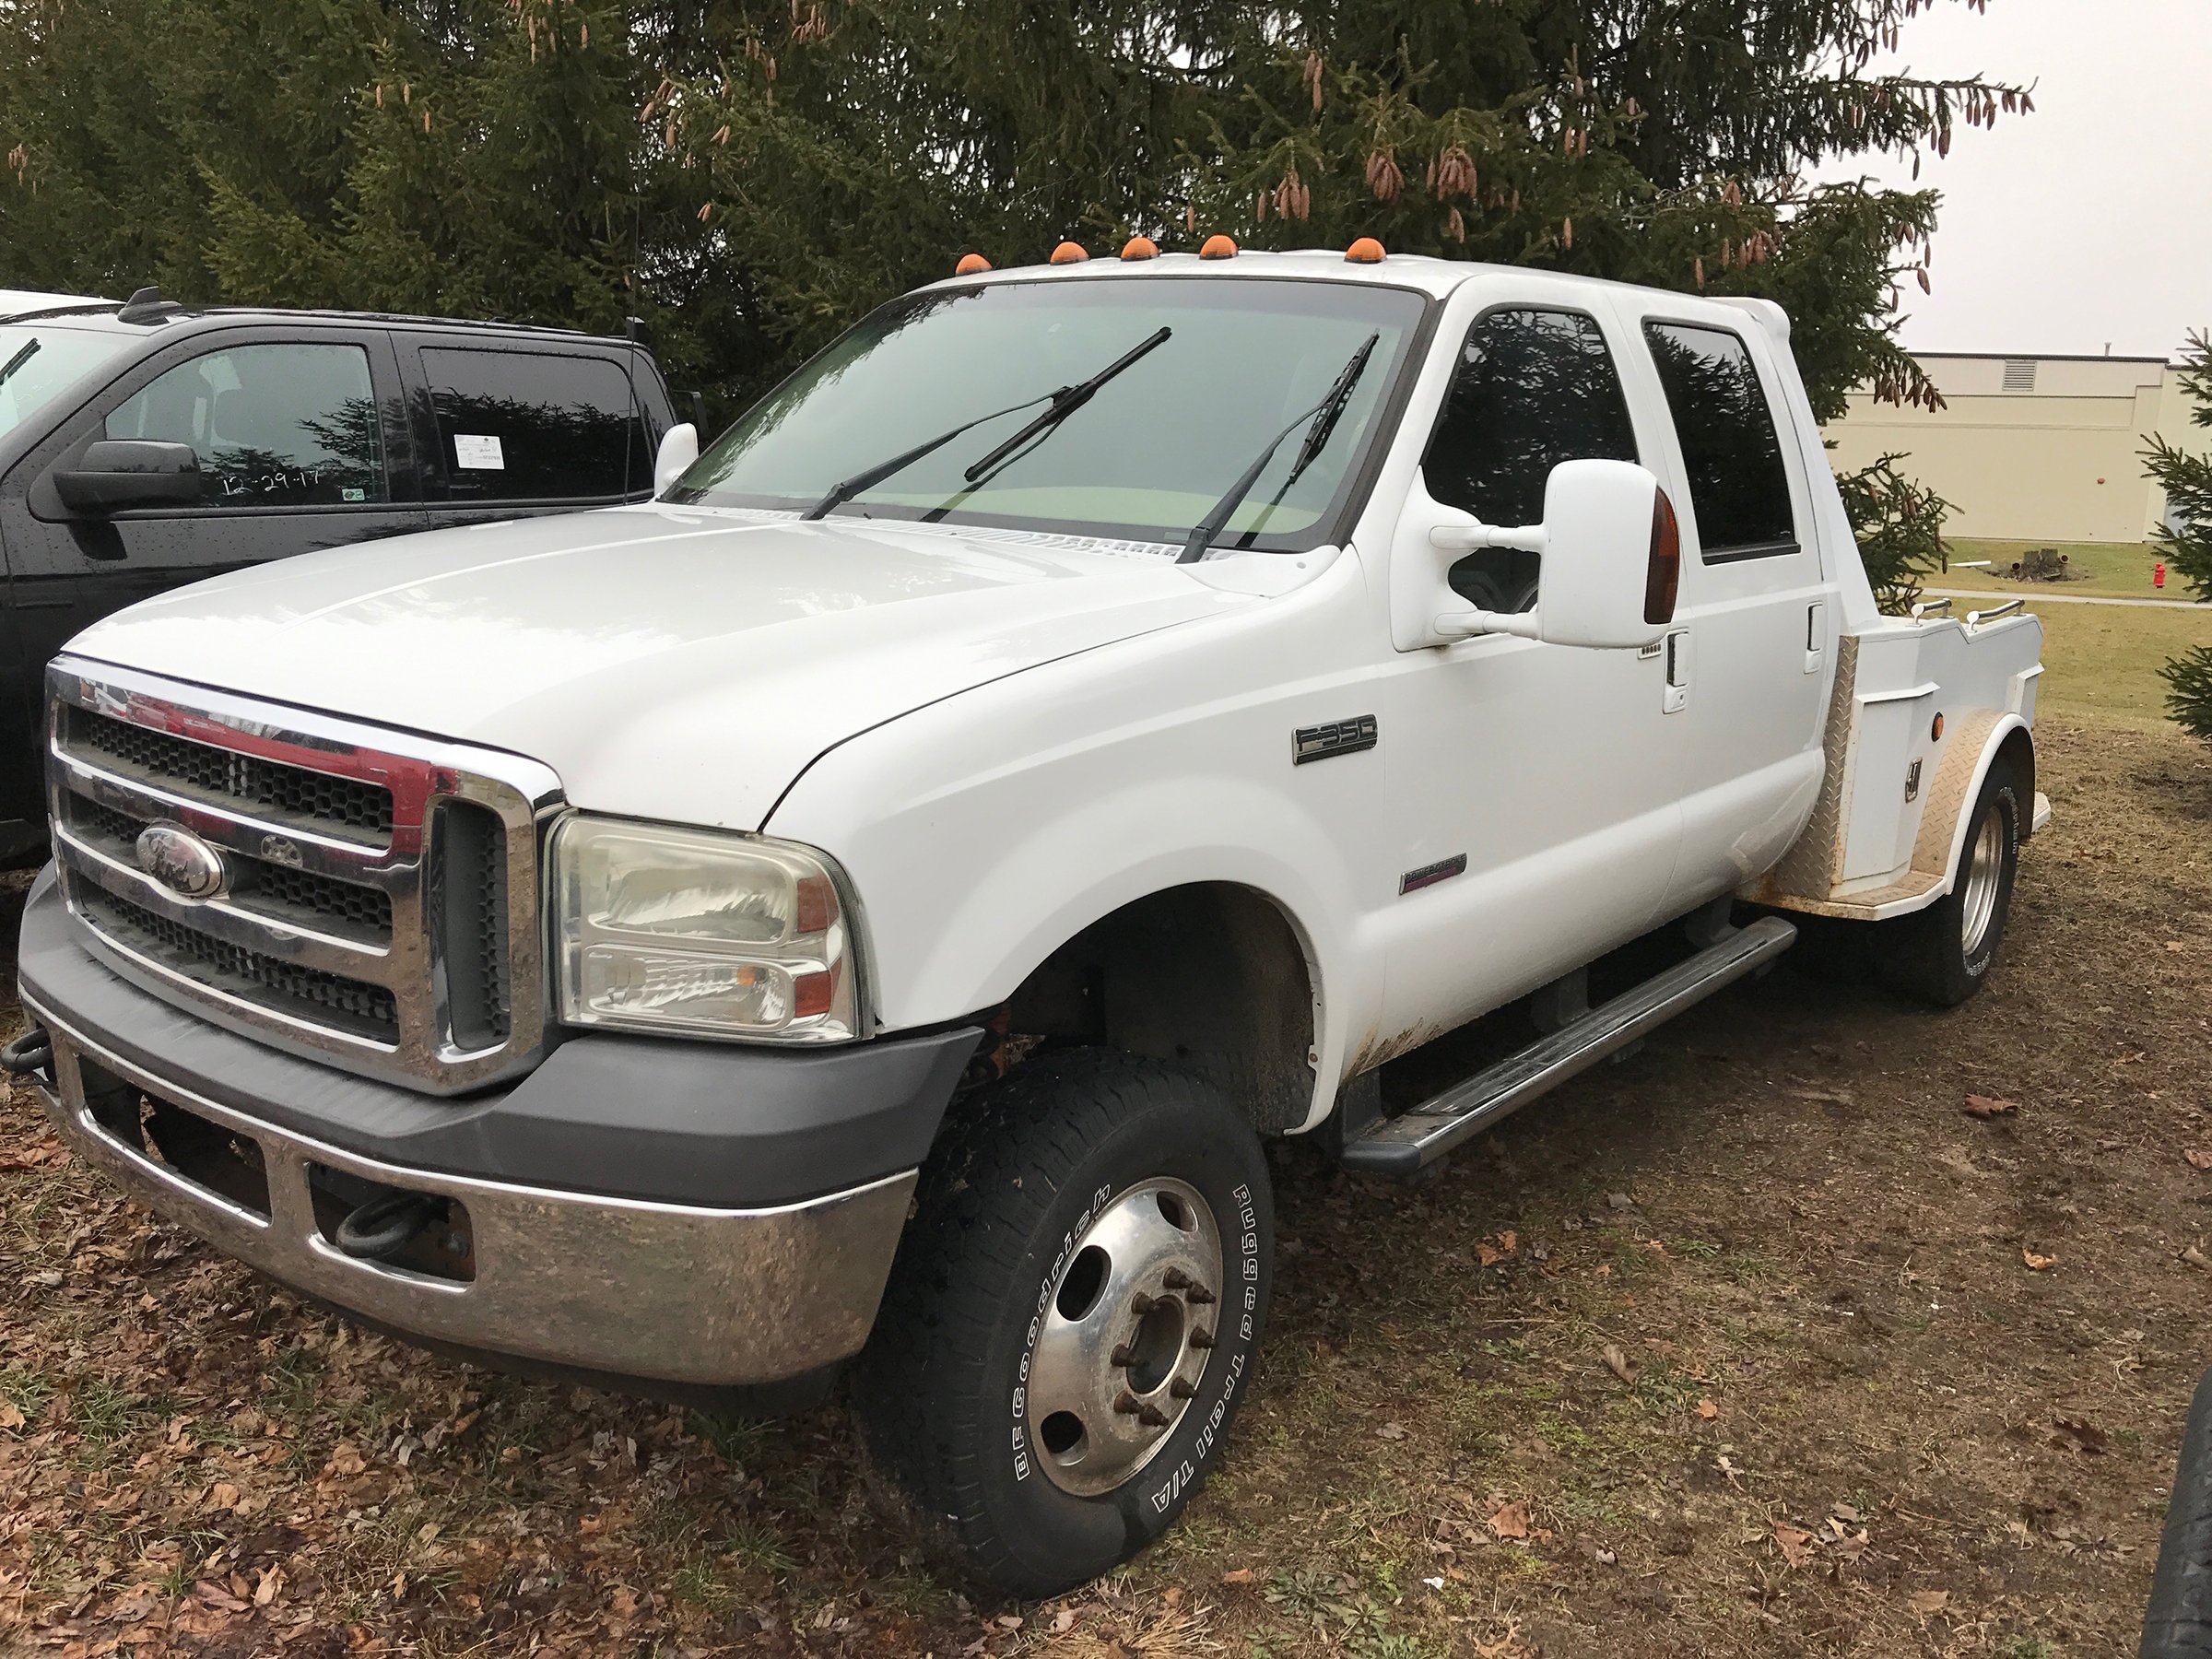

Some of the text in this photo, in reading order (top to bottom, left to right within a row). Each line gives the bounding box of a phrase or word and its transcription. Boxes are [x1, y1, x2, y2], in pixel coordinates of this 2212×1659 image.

[1295, 715, 1377, 755] F350
[1150, 1182, 1259, 1514] Rugged Trail T/A
